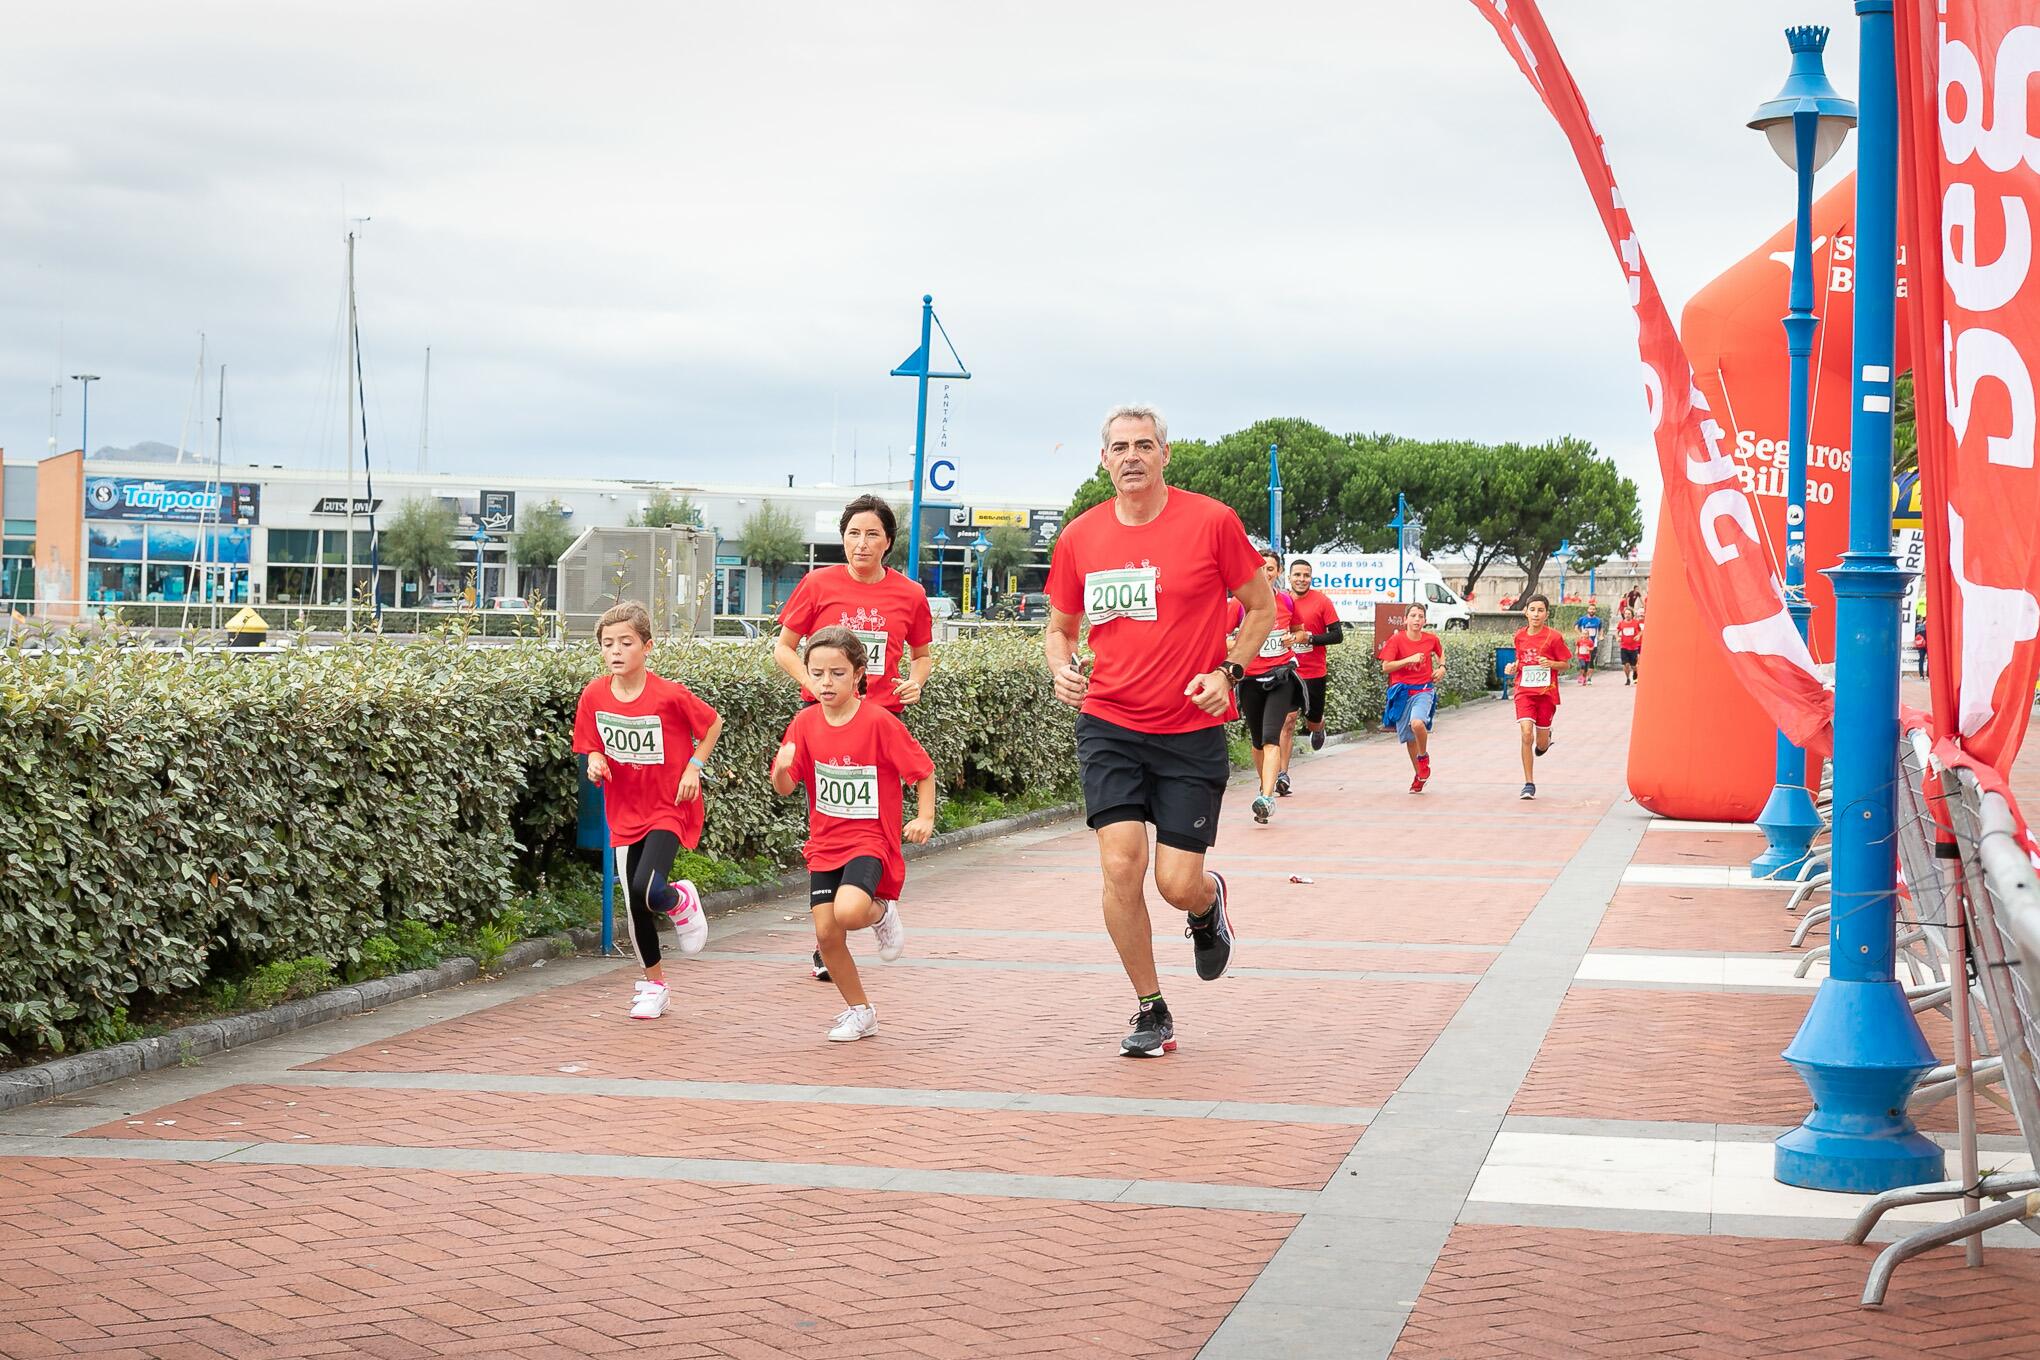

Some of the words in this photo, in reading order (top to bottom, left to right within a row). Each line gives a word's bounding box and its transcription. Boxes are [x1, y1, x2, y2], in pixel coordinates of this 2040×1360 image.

[940, 384, 950, 448] PANTALAN
[929, 460, 956, 491] C
[123, 484, 222, 512] Tarpoon
[1405, 561, 1416, 574] A
[1311, 573, 1400, 592] elefurgo
[1092, 583, 1148, 611] 2004
[1525, 671, 1548, 682] 2022
[603, 726, 656, 752] 2004
[820, 777, 871, 806] 2004
